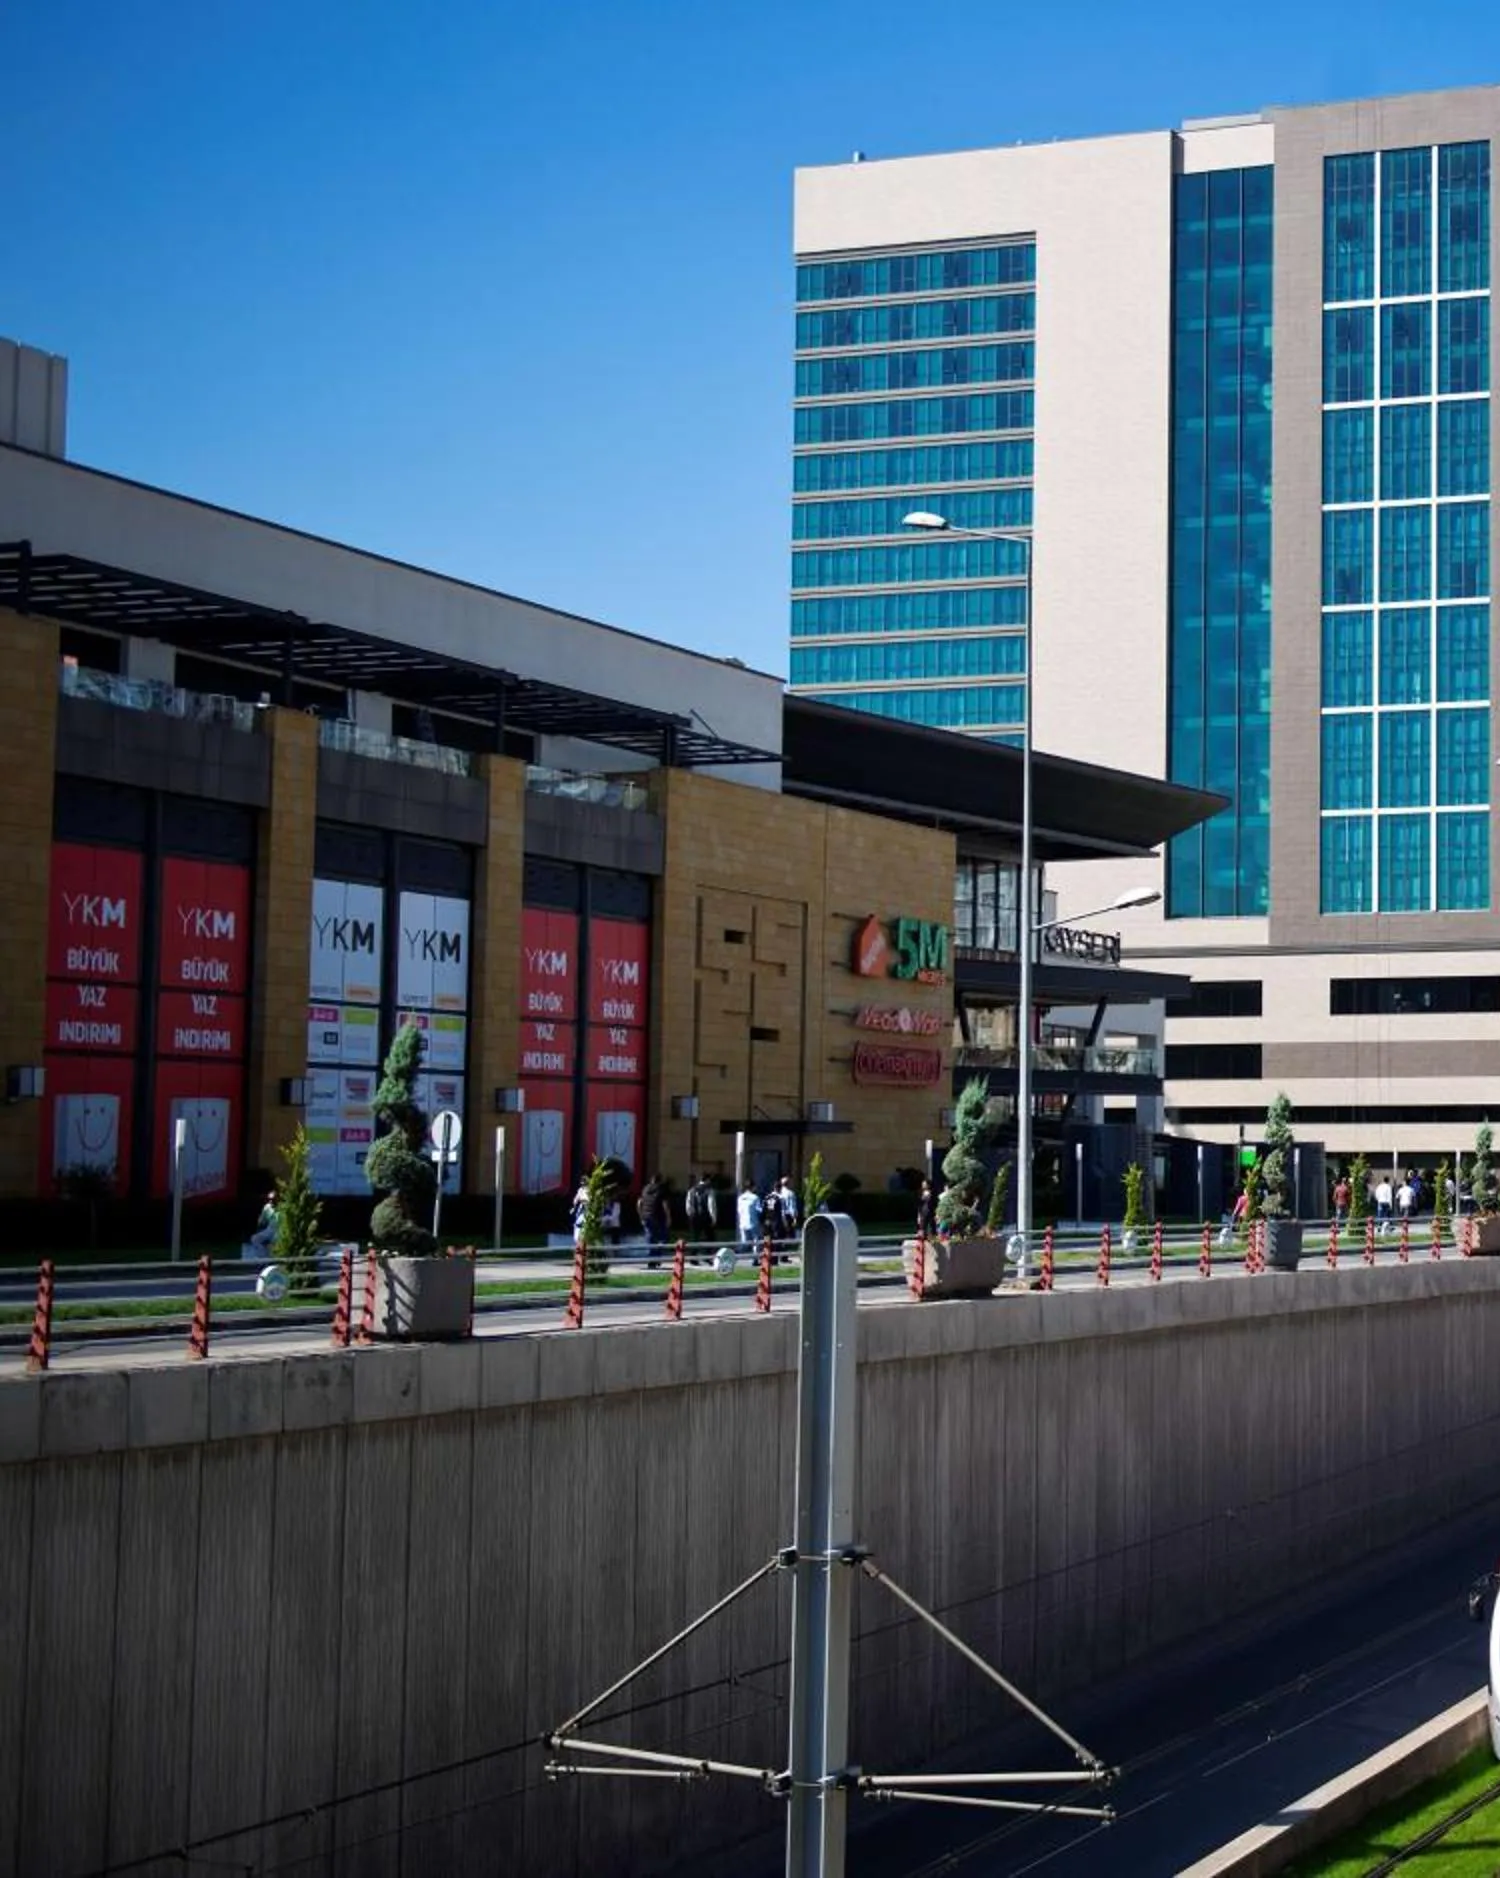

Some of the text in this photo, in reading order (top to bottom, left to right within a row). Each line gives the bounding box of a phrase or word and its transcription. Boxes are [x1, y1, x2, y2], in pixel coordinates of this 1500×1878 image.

[63, 892, 126, 928] YKM
[178, 905, 235, 940] YKM
[314, 915, 375, 954] YKM
[405, 928, 461, 964] YKM
[896, 918, 947, 979] 5M
[67, 946, 119, 973] BÜYÜK
[182, 957, 229, 982] BÜYÜK
[526, 948, 567, 976] YKM
[601, 959, 639, 985] YKM
[78, 985, 107, 1007] YAZ
[192, 994, 217, 1015] YAZ
